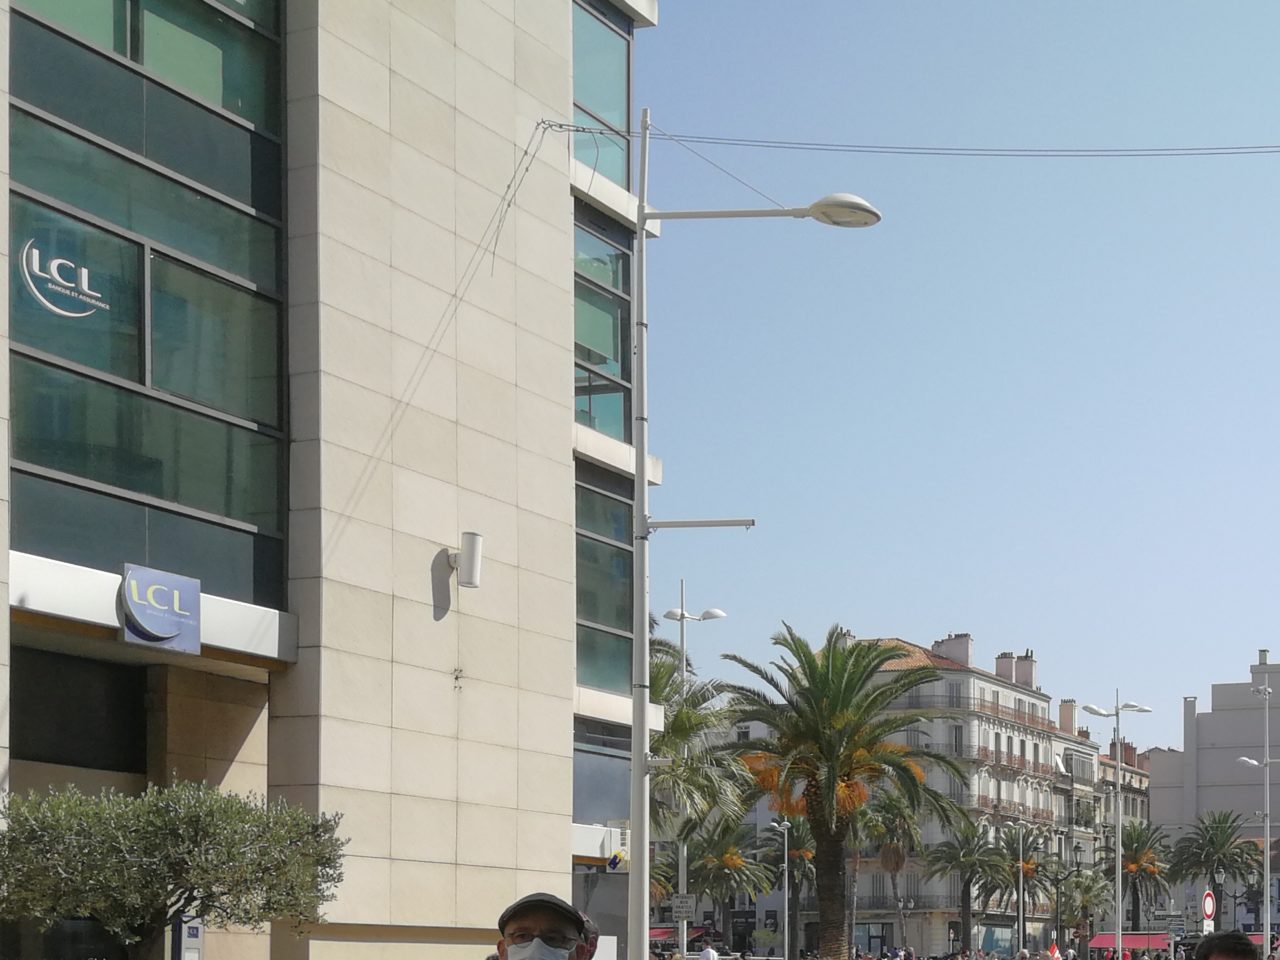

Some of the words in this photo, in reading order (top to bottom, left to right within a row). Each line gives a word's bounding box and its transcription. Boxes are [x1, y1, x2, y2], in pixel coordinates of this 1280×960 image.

[32, 248, 102, 298] LCL
[47, 283, 71, 296] BANQUE
[79, 294, 111, 310] ASSURANCE
[130, 579, 191, 616] LCL
